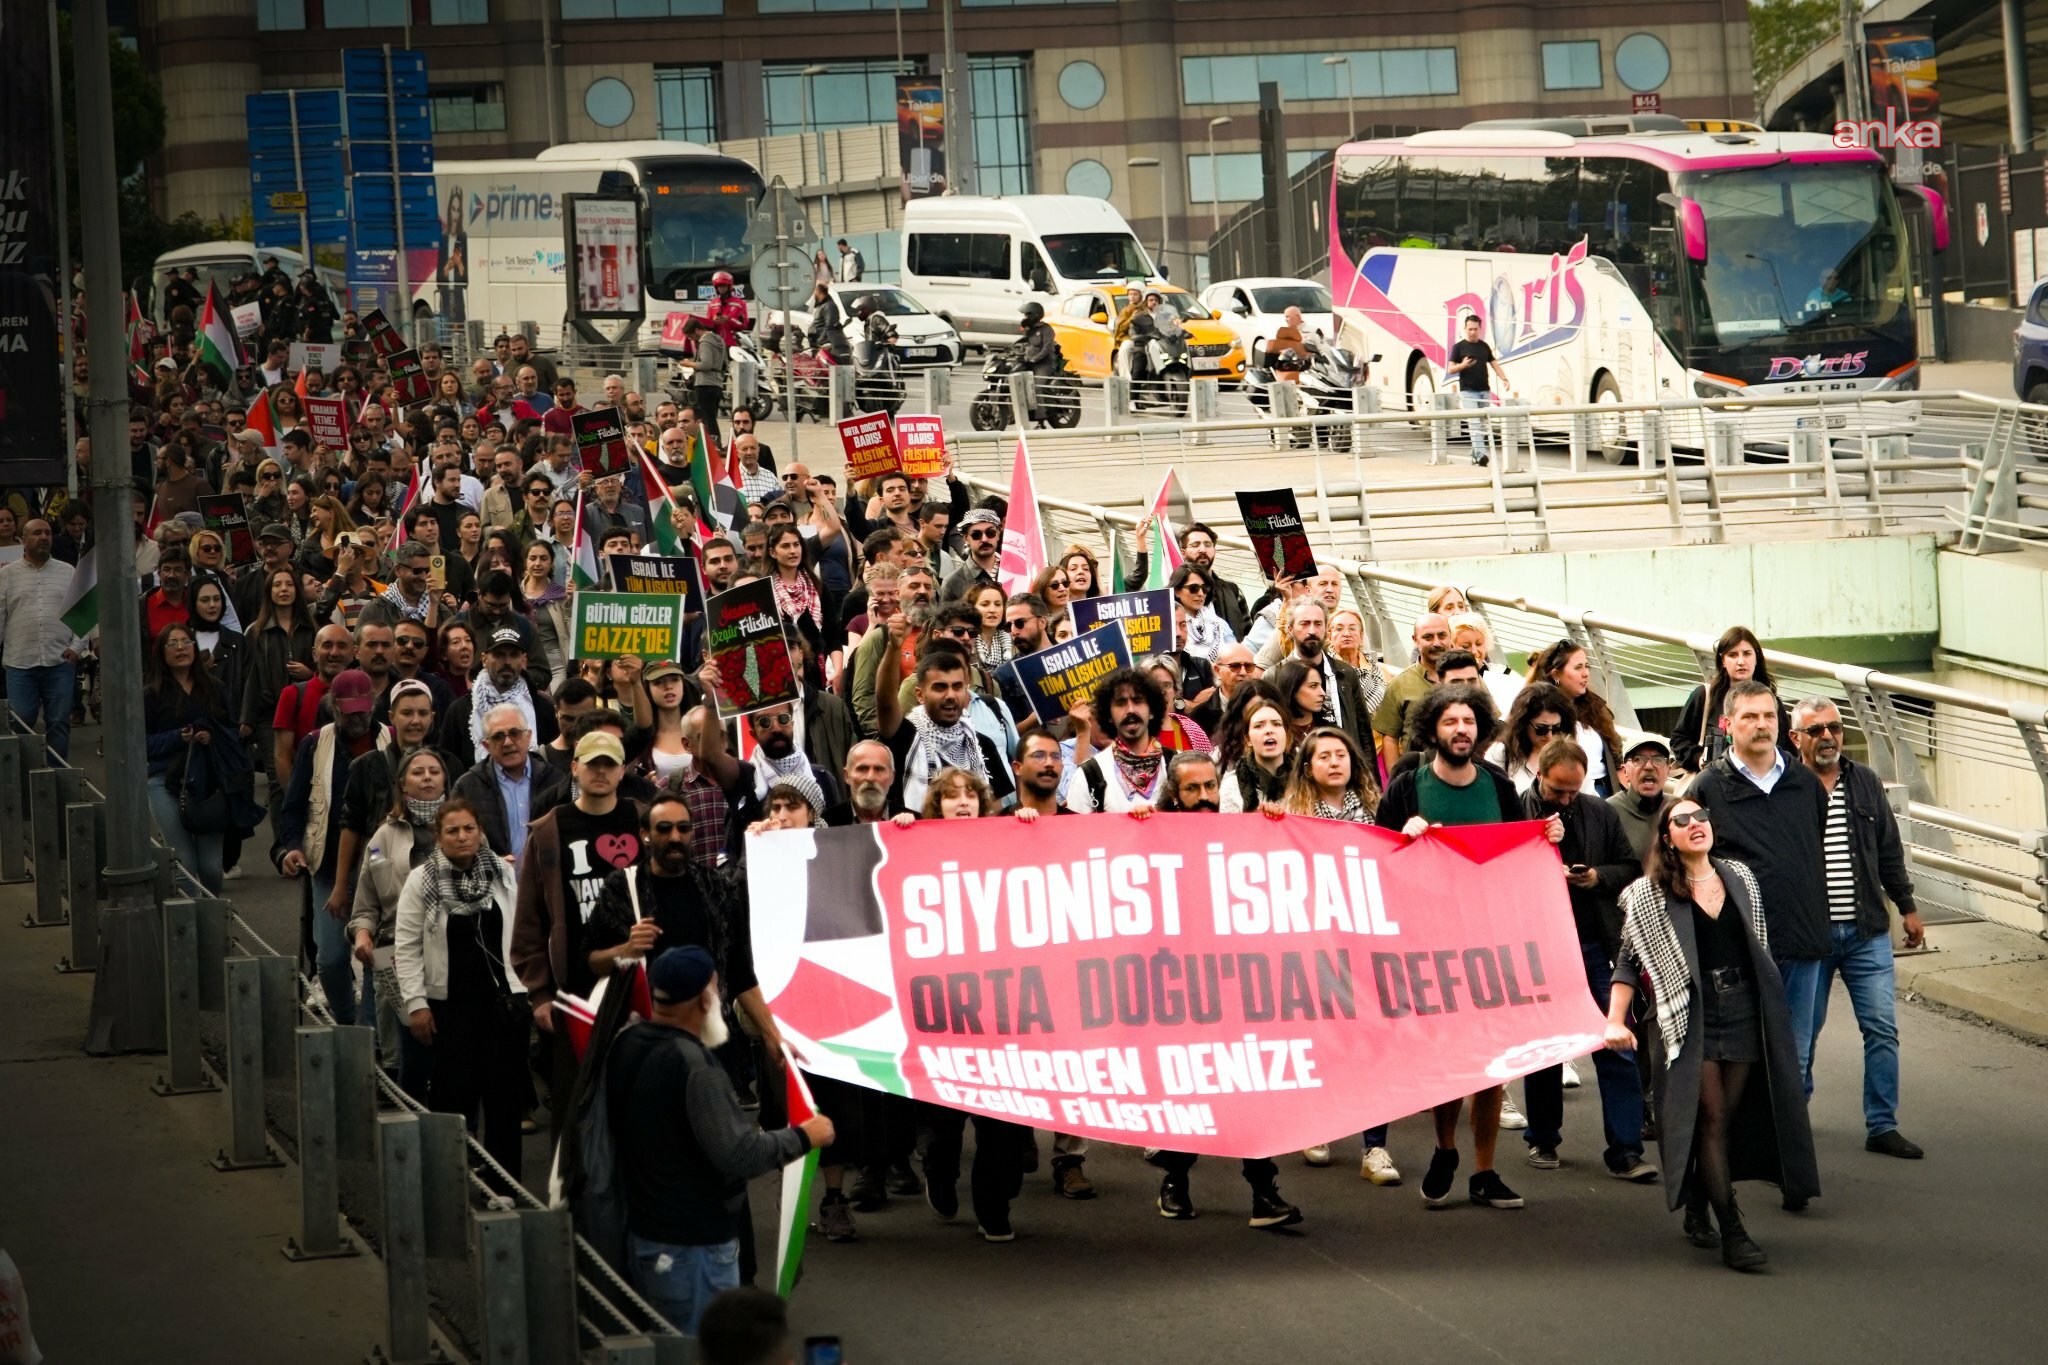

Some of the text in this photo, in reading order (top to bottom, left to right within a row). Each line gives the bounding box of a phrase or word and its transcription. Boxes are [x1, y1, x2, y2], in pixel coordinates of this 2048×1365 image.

[1882, 57, 1921, 73] Taksi
[486, 185, 552, 227] prime
[1764, 351, 1869, 381] Doris
[1784, 382, 1857, 394] SETRA
[843, 426, 860, 437] ORTA
[900, 423, 915, 432] ORTA
[907, 432, 935, 446] BARIŞ!
[853, 431, 883, 449] BARIŞ!
[852, 445, 893, 465] FİLİSTİN'E
[903, 447, 942, 462] FİLİSTİN'E
[1267, 513, 1301, 530] Filistin
[631, 559, 676, 578] İSRAİL İLE
[625, 576, 644, 593] TÜM
[585, 602, 672, 625] BÜTÜN GÖZLER
[1096, 597, 1150, 620] İSRAİL İLE
[738, 612, 779, 637] Filistin
[584, 626, 671, 654] GAZZE'DE!
[1041, 637, 1102, 675] İSRAİL İLE
[1038, 674, 1067, 698] TÜM
[568, 840, 592, 875] I
[902, 842, 1400, 959] SİYONİST İSRAİL
[909, 941, 1552, 1035] ORTA DOĞU'DAN DEFOL!
[918, 1033, 1323, 1098] NEHİRDEN DENİZE
[932, 1078, 1219, 1136] ÖZGÜR FİLİSTİN!
